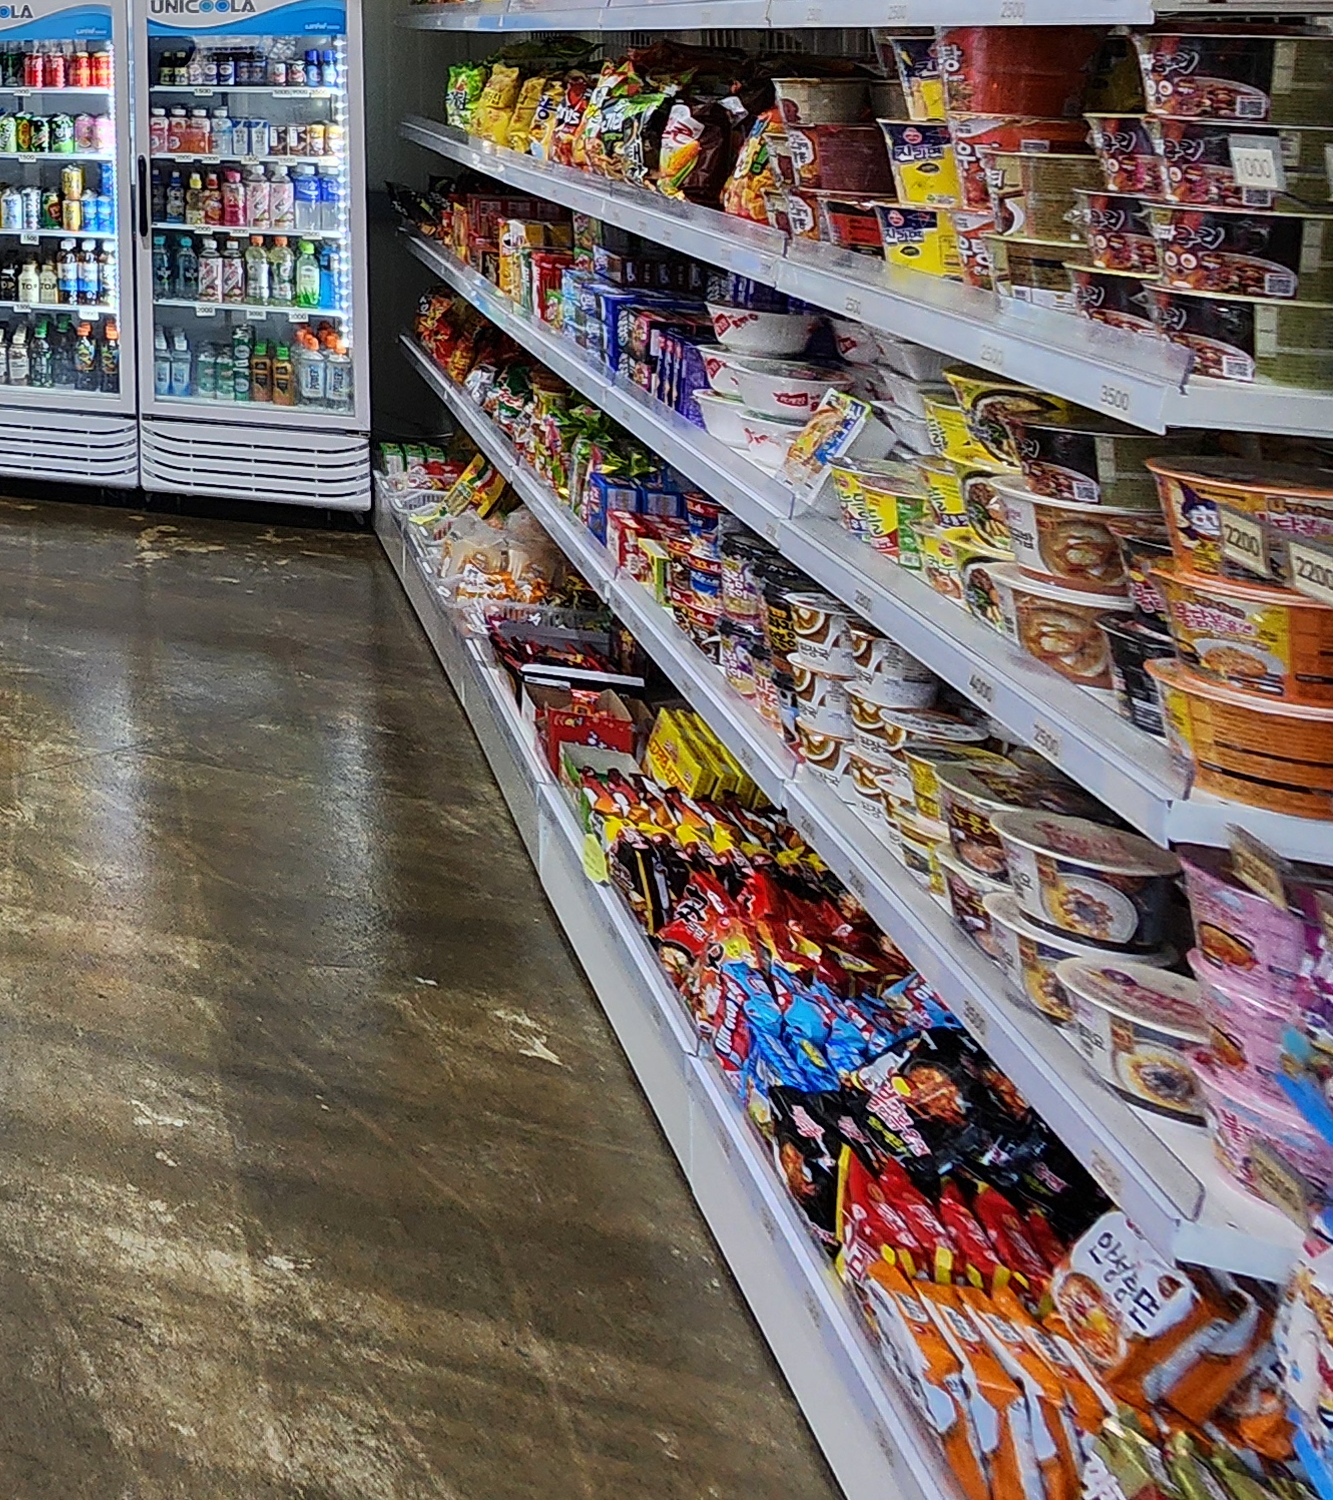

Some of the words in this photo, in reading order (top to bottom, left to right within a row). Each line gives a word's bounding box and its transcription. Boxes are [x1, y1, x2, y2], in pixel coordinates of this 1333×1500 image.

[1237, 157, 1272, 178] 1000
[1101, 385, 1130, 411] 3500
[1224, 523, 1260, 557] 2200
[1088, 1231, 1161, 1331] 안성탕면
